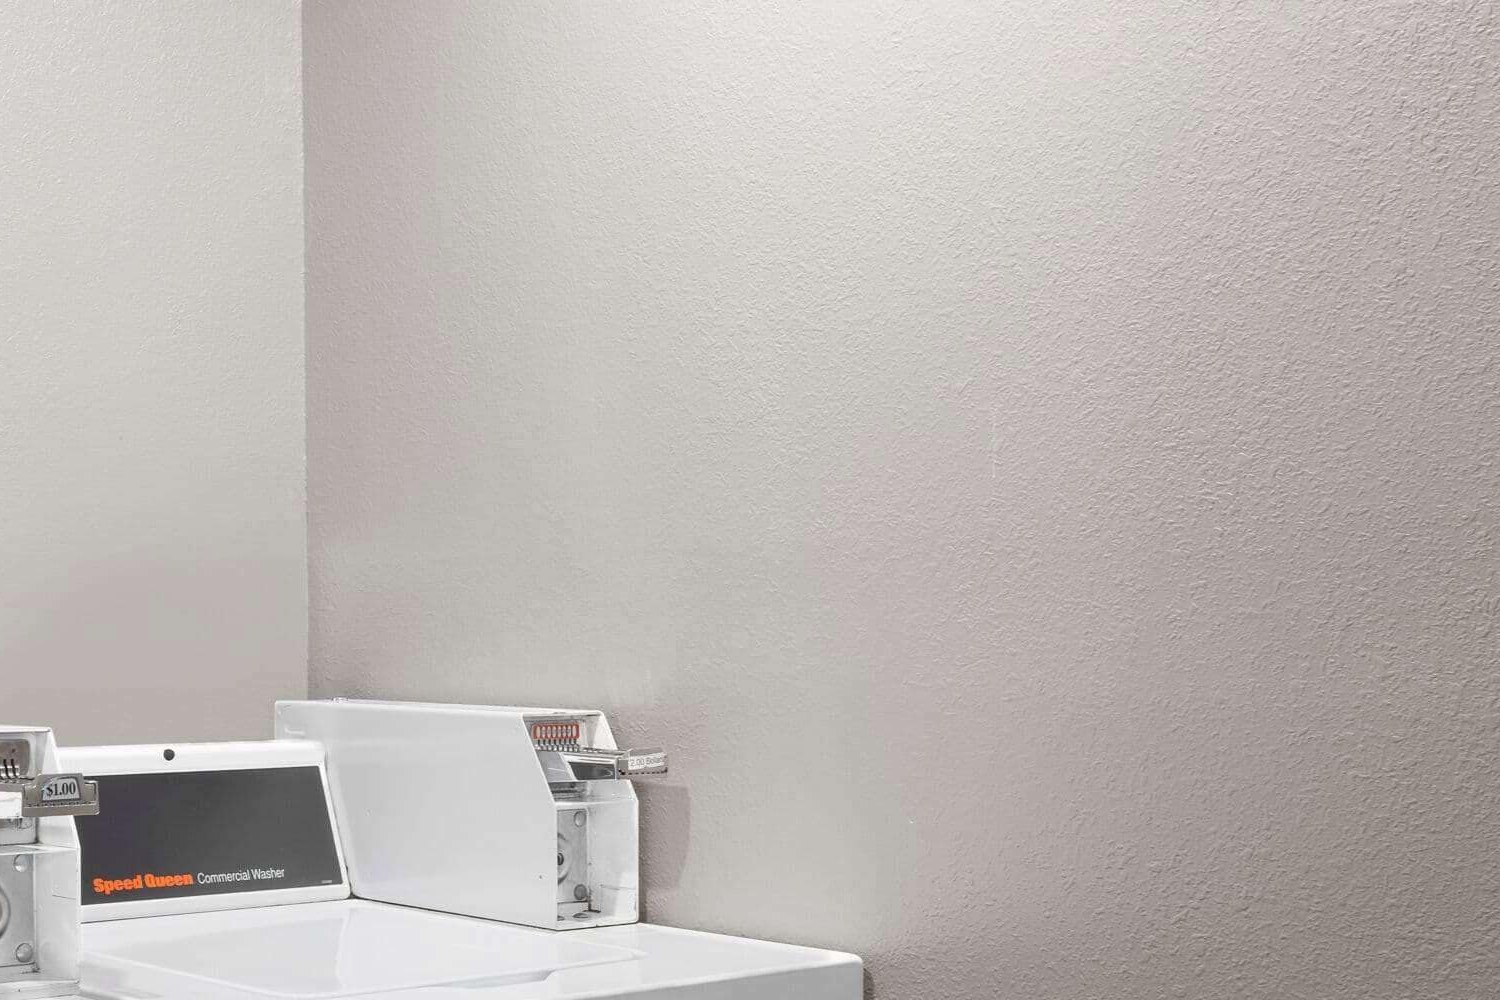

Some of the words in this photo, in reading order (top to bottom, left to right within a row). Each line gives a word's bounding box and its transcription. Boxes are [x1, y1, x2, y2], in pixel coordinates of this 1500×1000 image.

[45, 782, 76, 796] $1.00
[93, 874, 143, 895] Speed
[144, 873, 194, 888] Queen
[197, 870, 250, 884] Commercial
[250, 868, 285, 880] Washer
